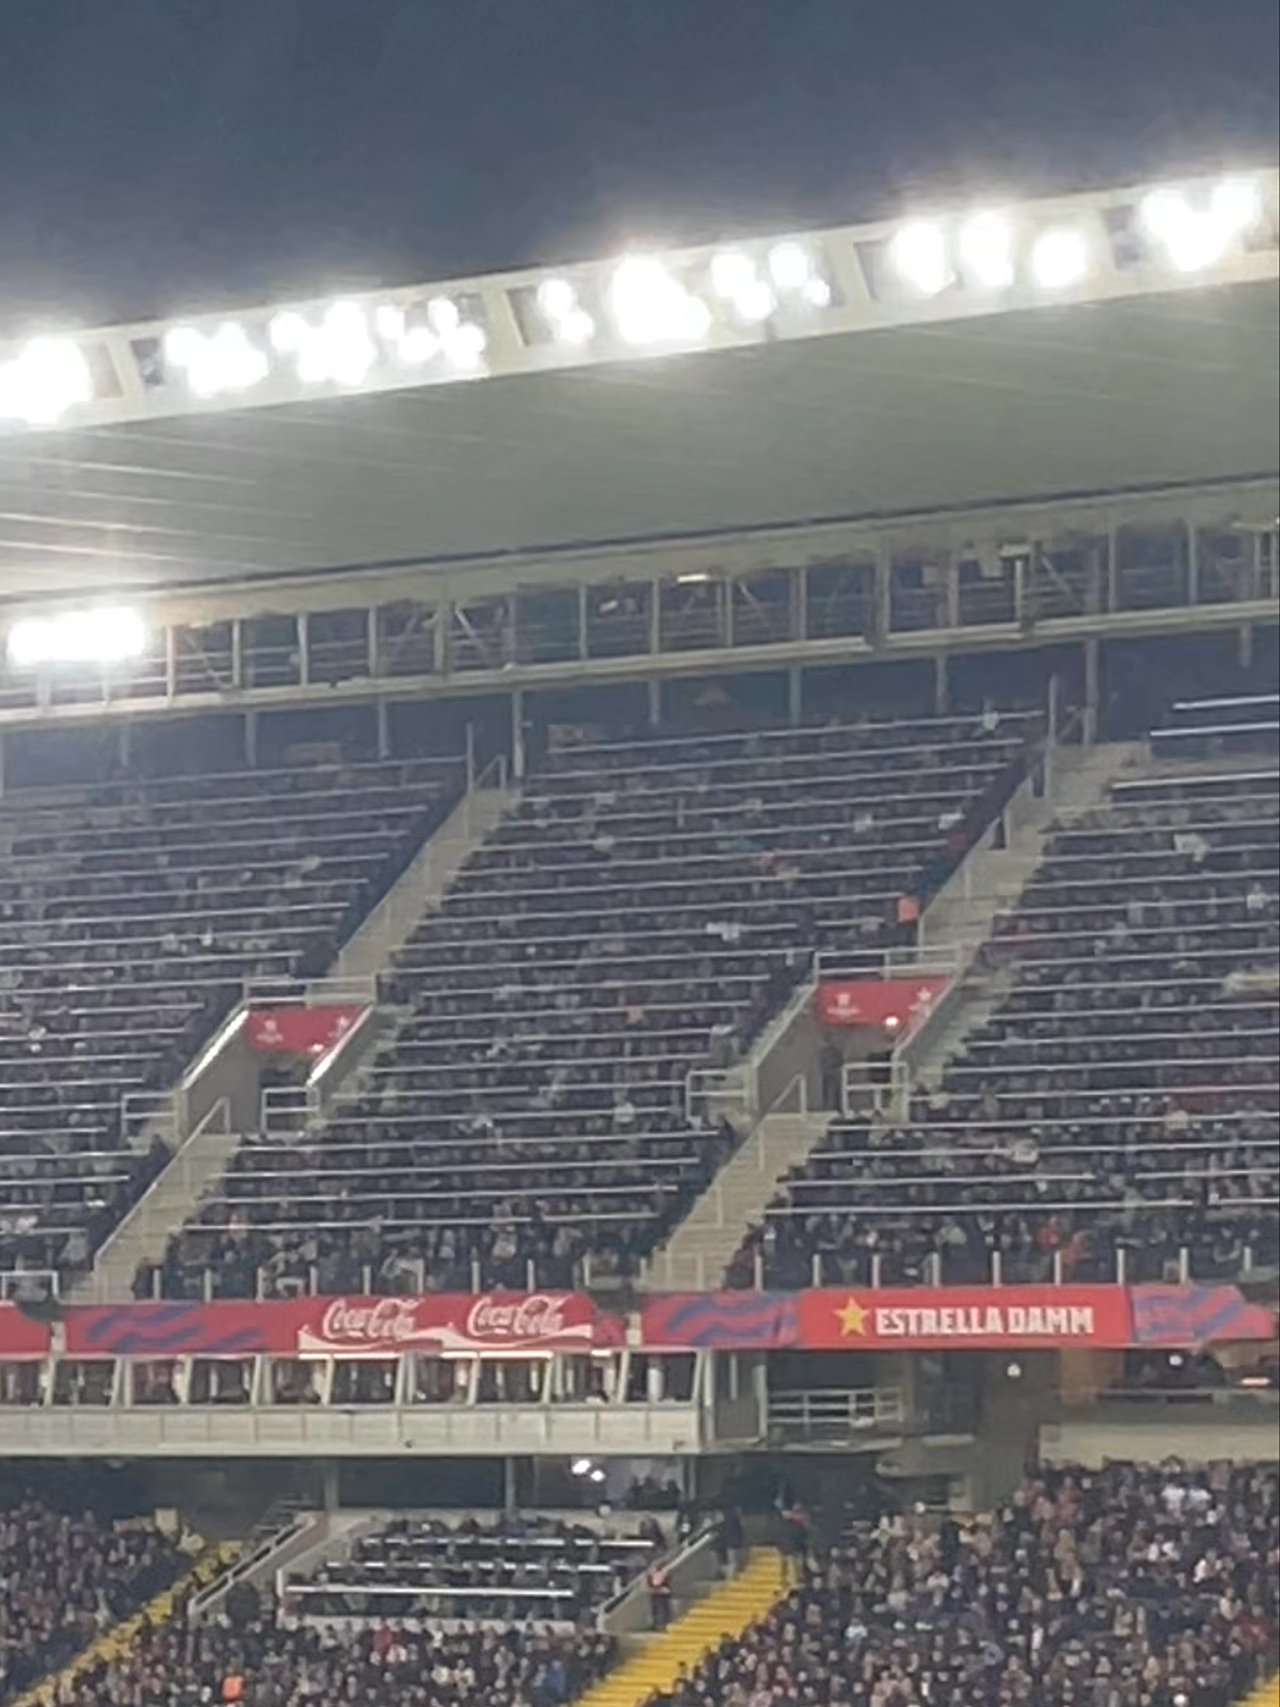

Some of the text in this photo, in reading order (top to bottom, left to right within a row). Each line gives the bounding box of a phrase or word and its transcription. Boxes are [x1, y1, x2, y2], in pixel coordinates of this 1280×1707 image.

[322, 1297, 423, 1339] Coca-Cola
[467, 1294, 568, 1337] Coca-Cola
[874, 1306, 1095, 1335] ESTRELLA DAMM
